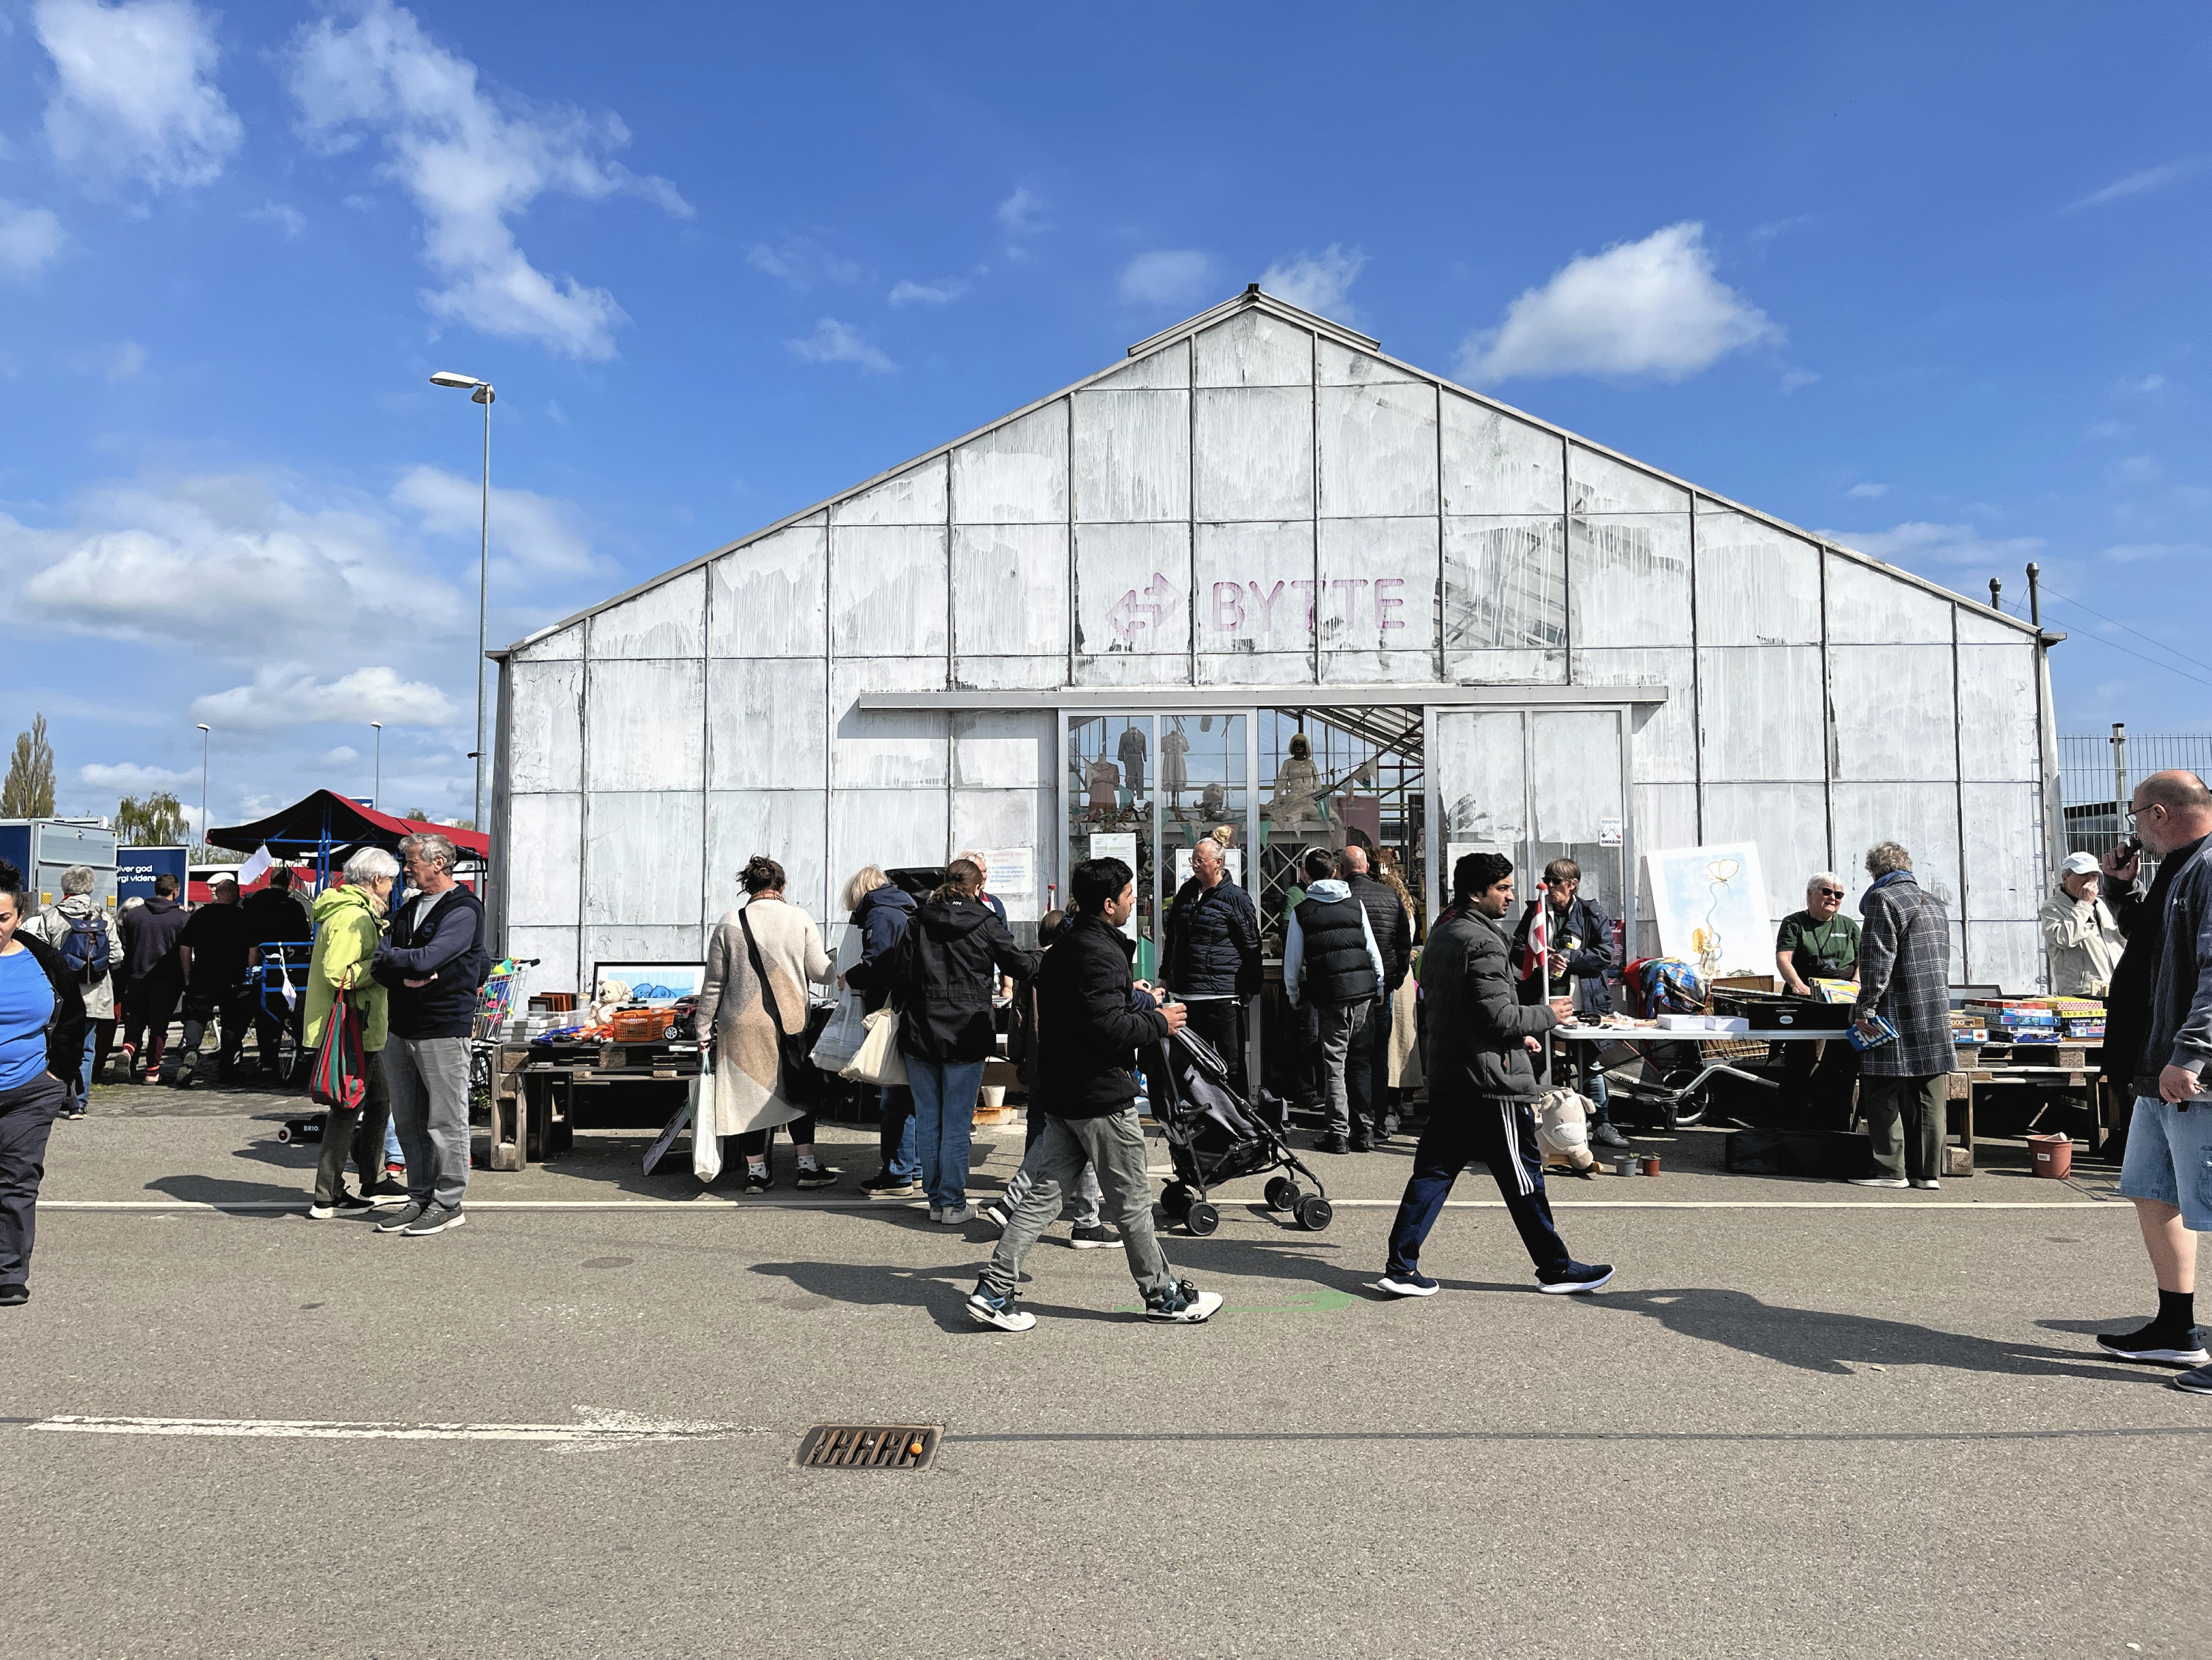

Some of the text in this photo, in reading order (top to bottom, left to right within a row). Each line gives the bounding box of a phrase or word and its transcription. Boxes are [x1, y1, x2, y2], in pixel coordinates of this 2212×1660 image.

[1213, 578, 1405, 631] BYTTE
[136, 865, 153, 874] god
[116, 875, 129, 883] rgi
